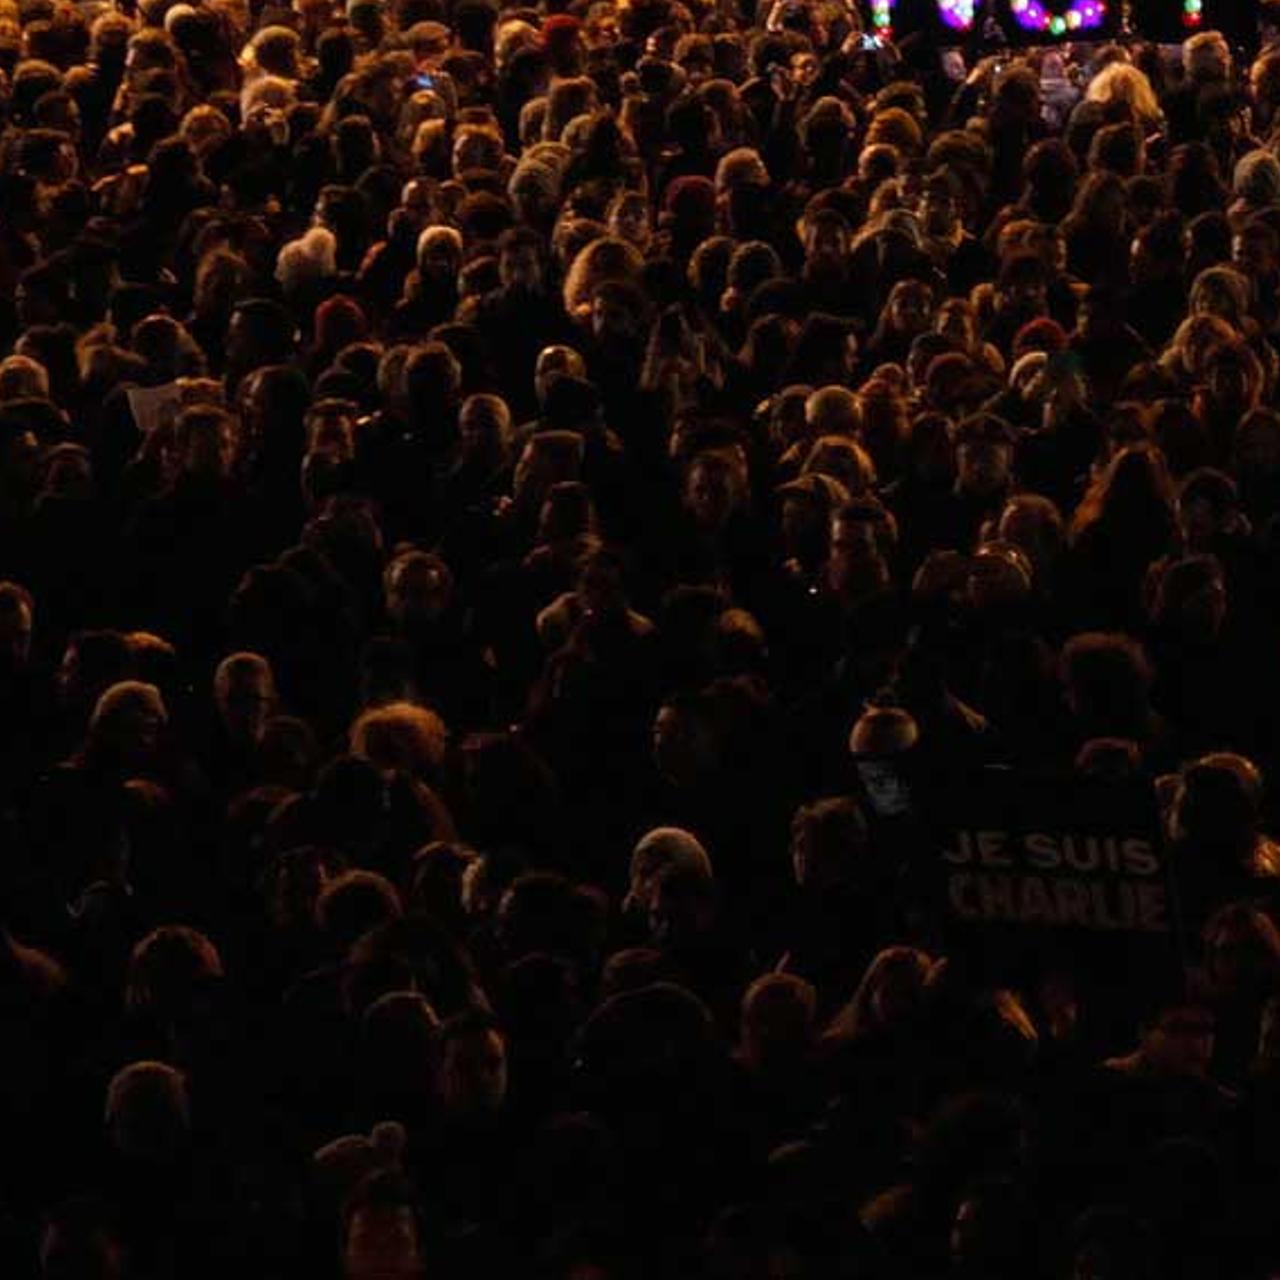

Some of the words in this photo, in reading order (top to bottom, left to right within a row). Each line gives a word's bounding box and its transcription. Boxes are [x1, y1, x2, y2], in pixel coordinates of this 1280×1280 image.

[940, 830, 1012, 864] JE
[1023, 832, 1160, 876] SUIS
[948, 872, 1170, 933] CHARLIE
